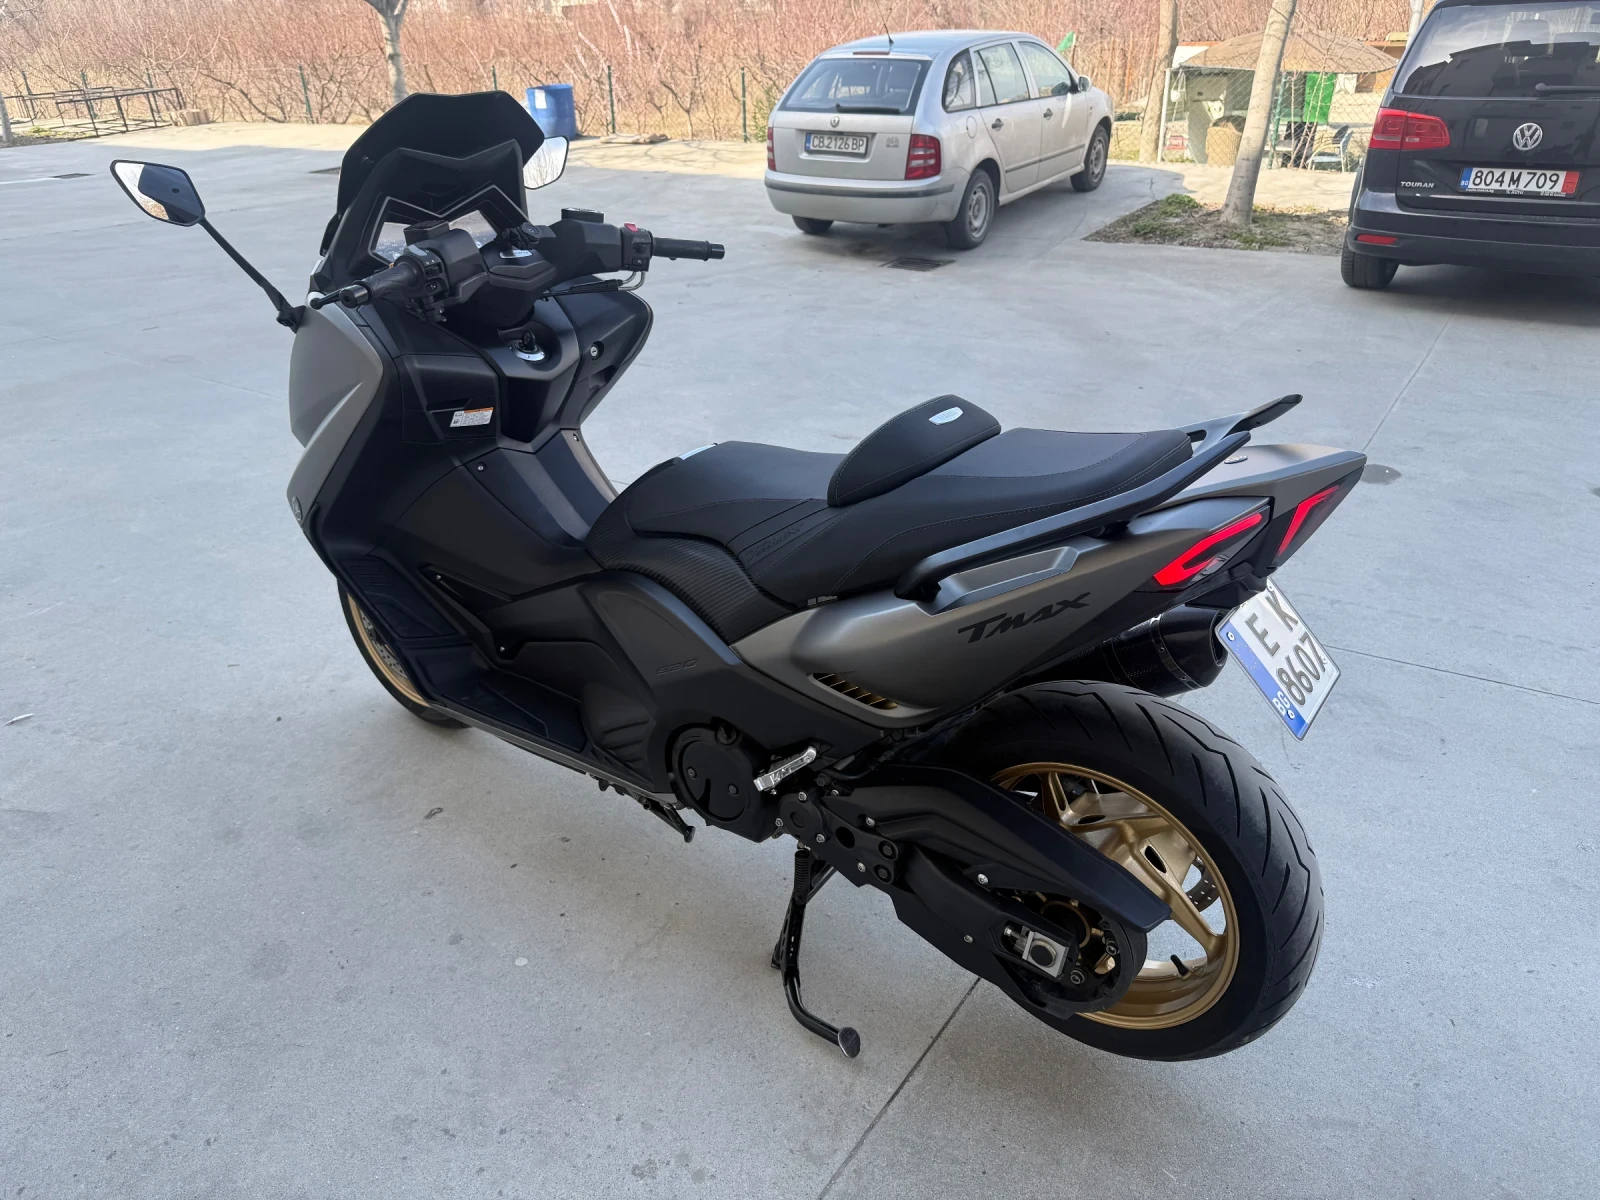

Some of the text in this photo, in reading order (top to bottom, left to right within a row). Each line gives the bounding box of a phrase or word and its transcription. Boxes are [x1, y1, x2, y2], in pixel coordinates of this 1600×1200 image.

[812, 135, 865, 151] CB 2126 BP
[1400, 181, 1435, 189] TOURAN
[1472, 170, 1560, 190] 804 M 709
[957, 592, 1091, 644] TMAX
[1245, 590, 1299, 657] E K
[1275, 631, 1326, 706] 8607
[1272, 690, 1291, 717] BG
